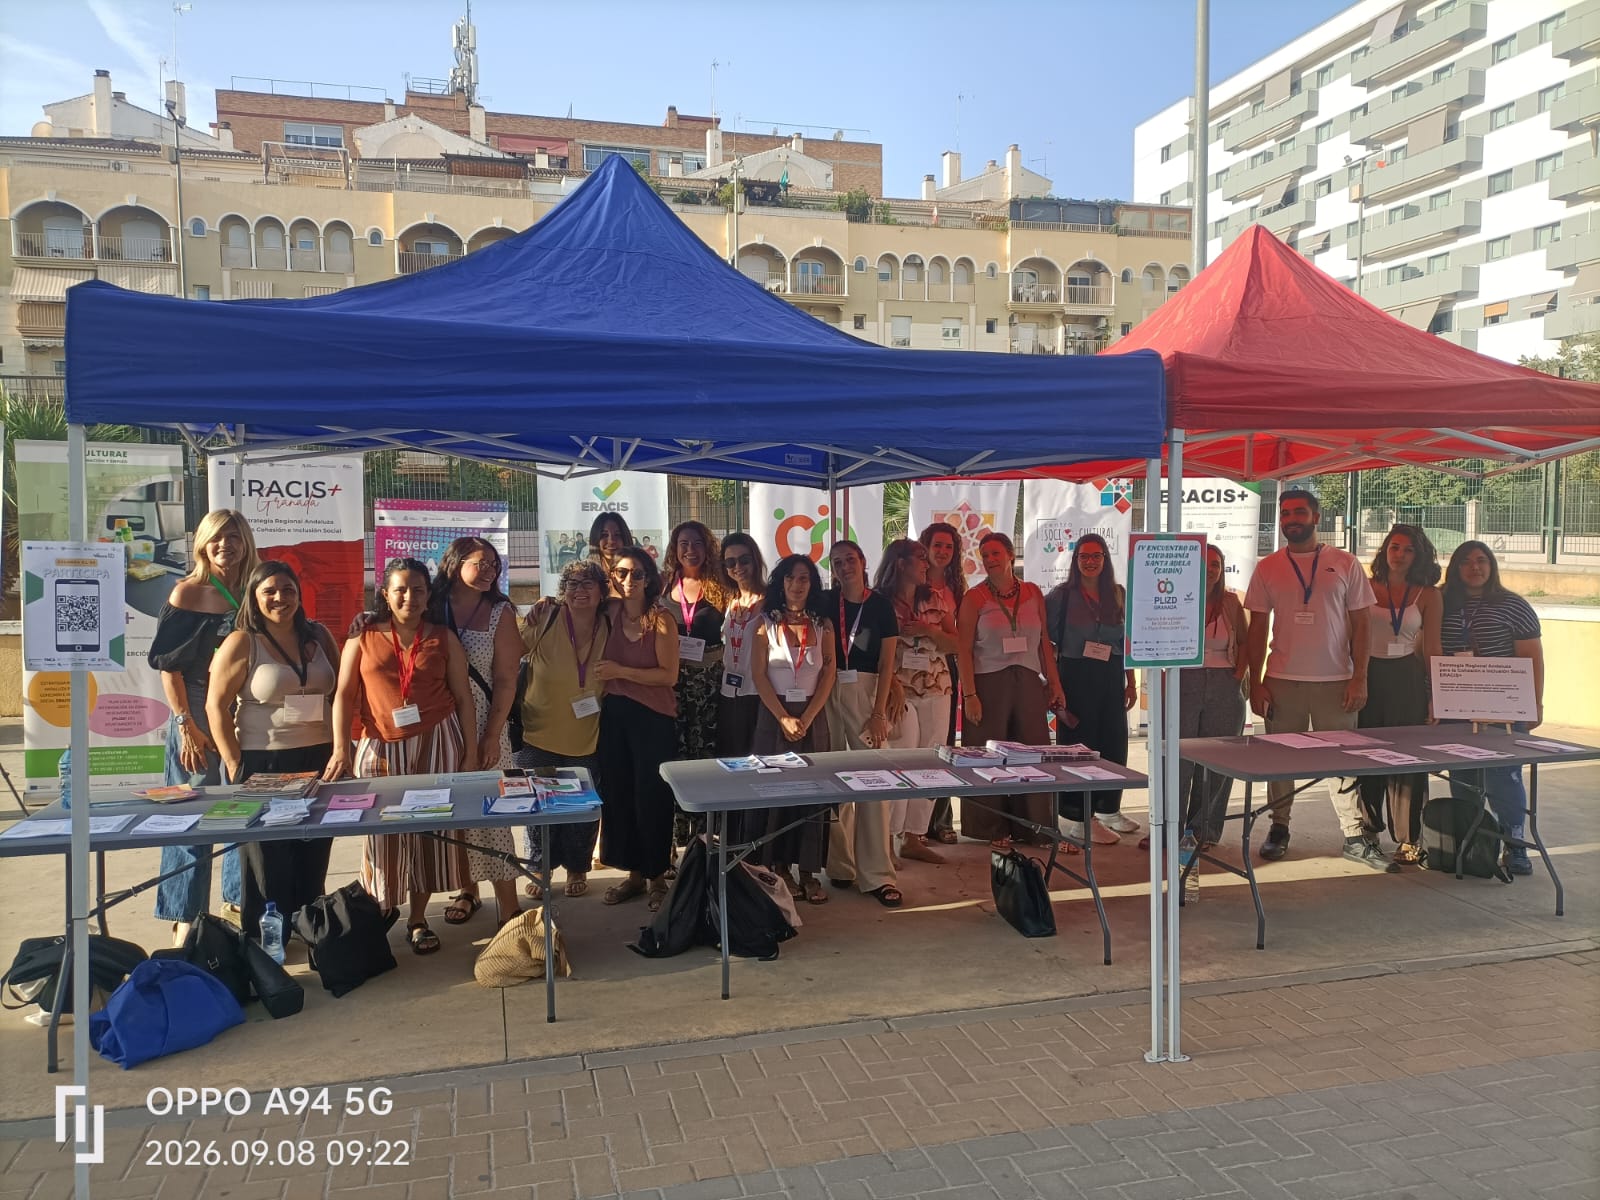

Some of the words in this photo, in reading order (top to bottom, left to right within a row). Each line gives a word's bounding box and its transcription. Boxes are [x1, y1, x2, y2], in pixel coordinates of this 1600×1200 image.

[85, 449, 128, 457] ULTURAE
[257, 487, 320, 516] Granada
[581, 502, 629, 512] ERACIS
[385, 539, 439, 552] Proyecto
[1154, 596, 1177, 605] PLIZD
